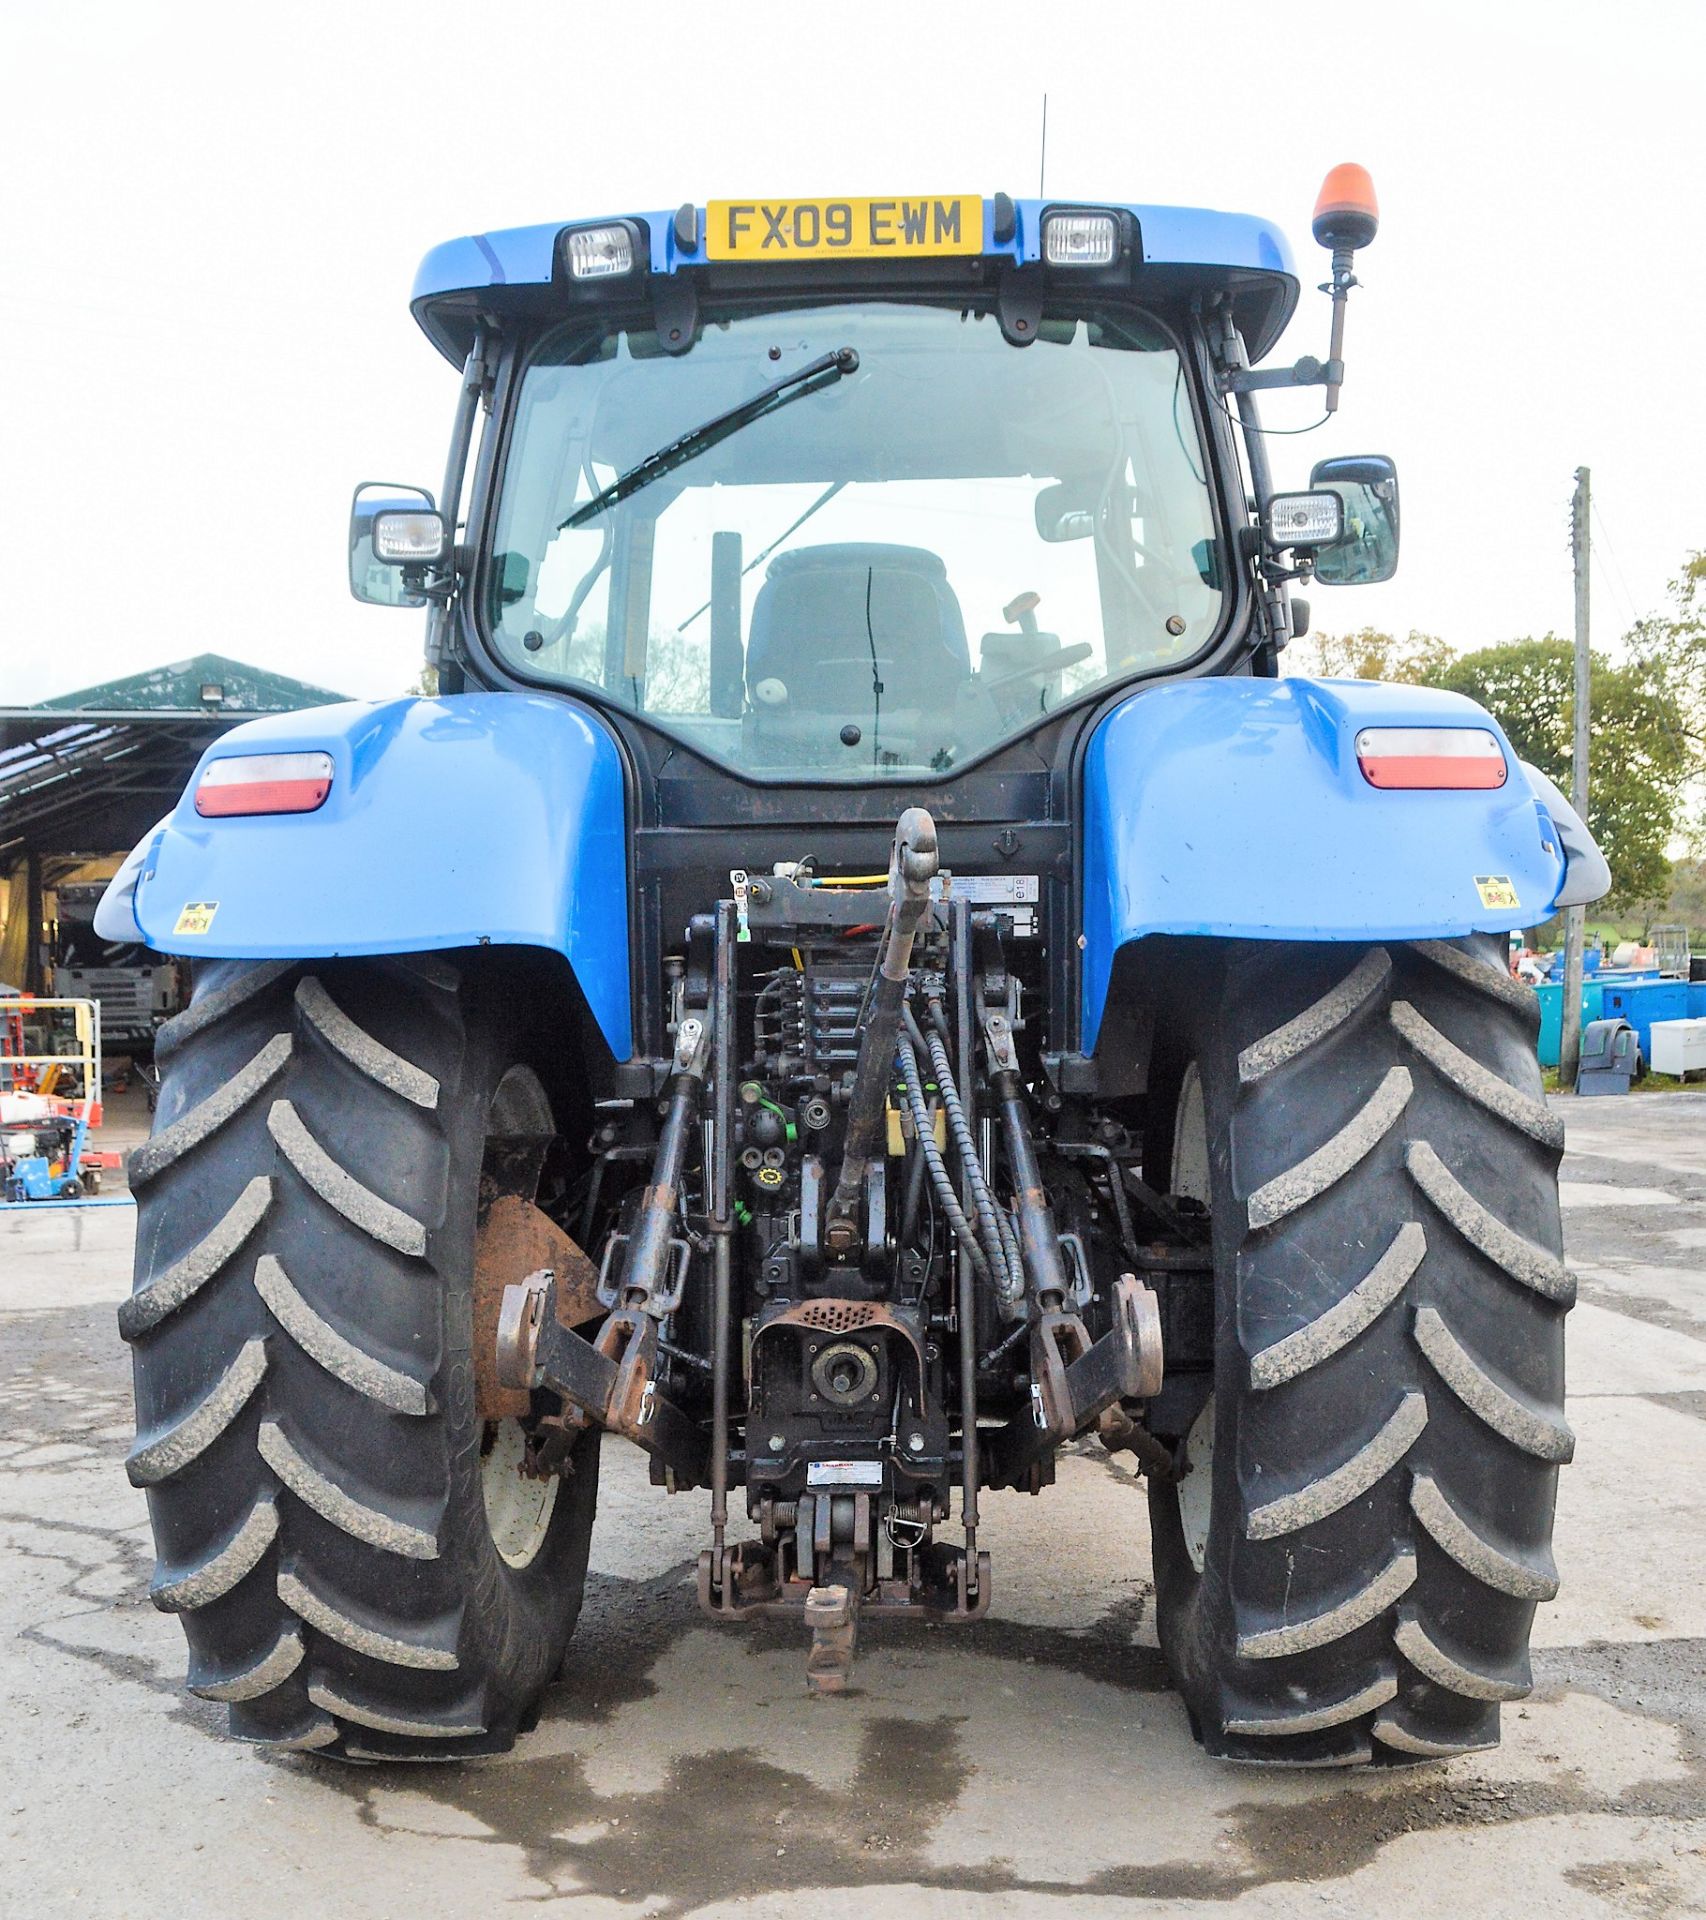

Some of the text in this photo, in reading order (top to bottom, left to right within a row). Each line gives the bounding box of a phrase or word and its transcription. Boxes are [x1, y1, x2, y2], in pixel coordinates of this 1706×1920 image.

[728, 200, 961, 248] FX09 EWM
[1015, 879, 1025, 899] e18
